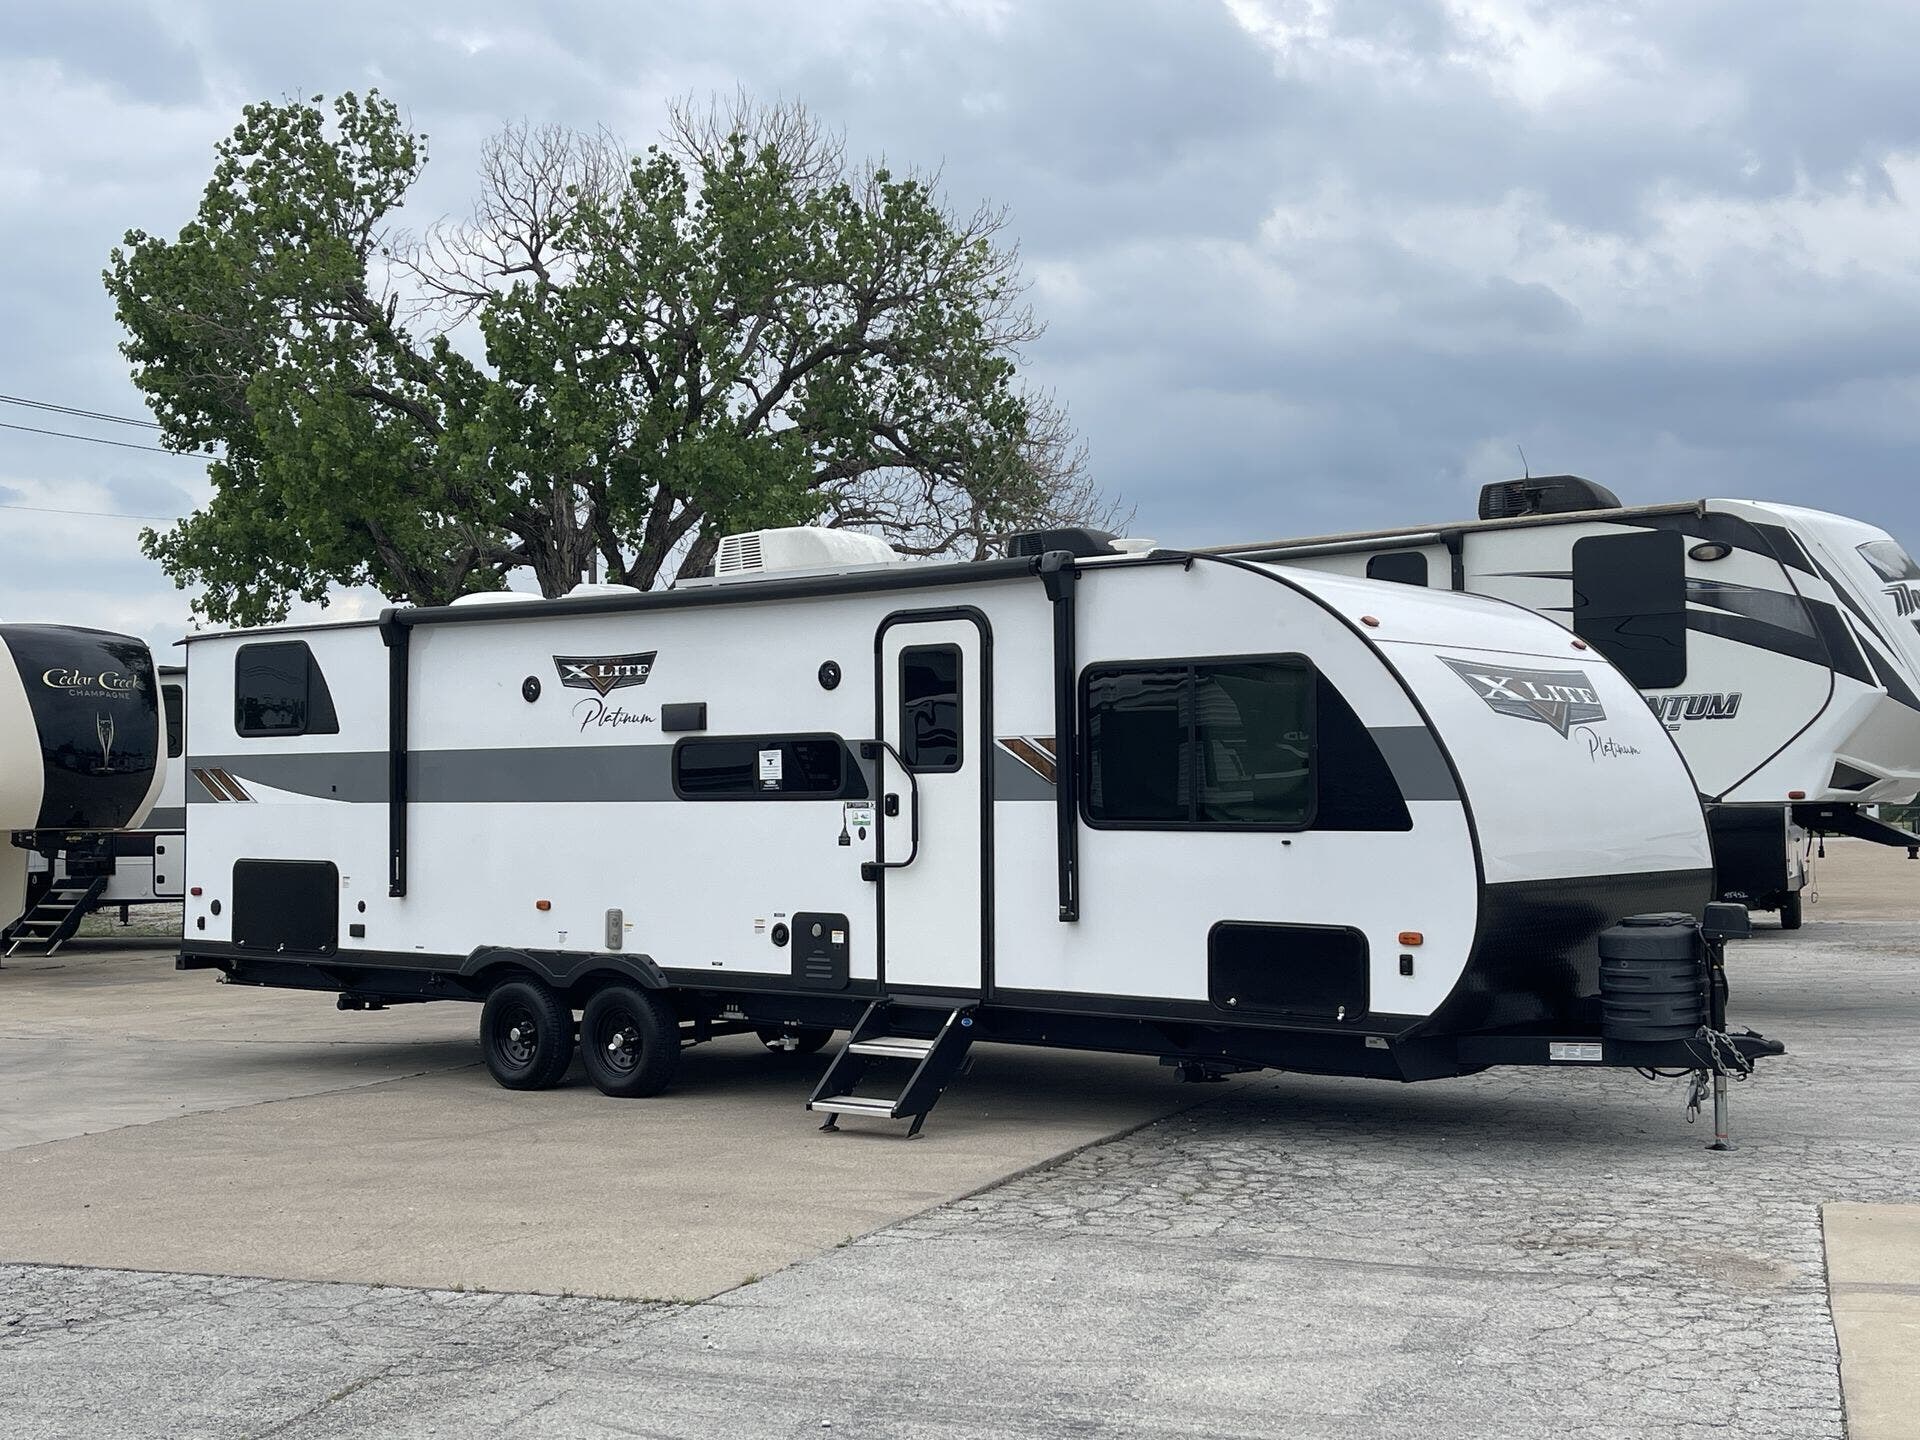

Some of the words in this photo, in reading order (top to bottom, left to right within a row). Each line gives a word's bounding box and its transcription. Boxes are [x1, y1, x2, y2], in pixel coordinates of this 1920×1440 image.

[42, 668, 95, 689] Cedar
[98, 671, 146, 691] Creek
[561, 663, 595, 680] X
[597, 664, 649, 677] LITE
[68, 689, 132, 700] CHAMPAGNE
[1465, 673, 1531, 702] X
[1521, 681, 1600, 705] LITE
[572, 697, 657, 733] Platinum
[1574, 726, 1641, 763] Platinum
